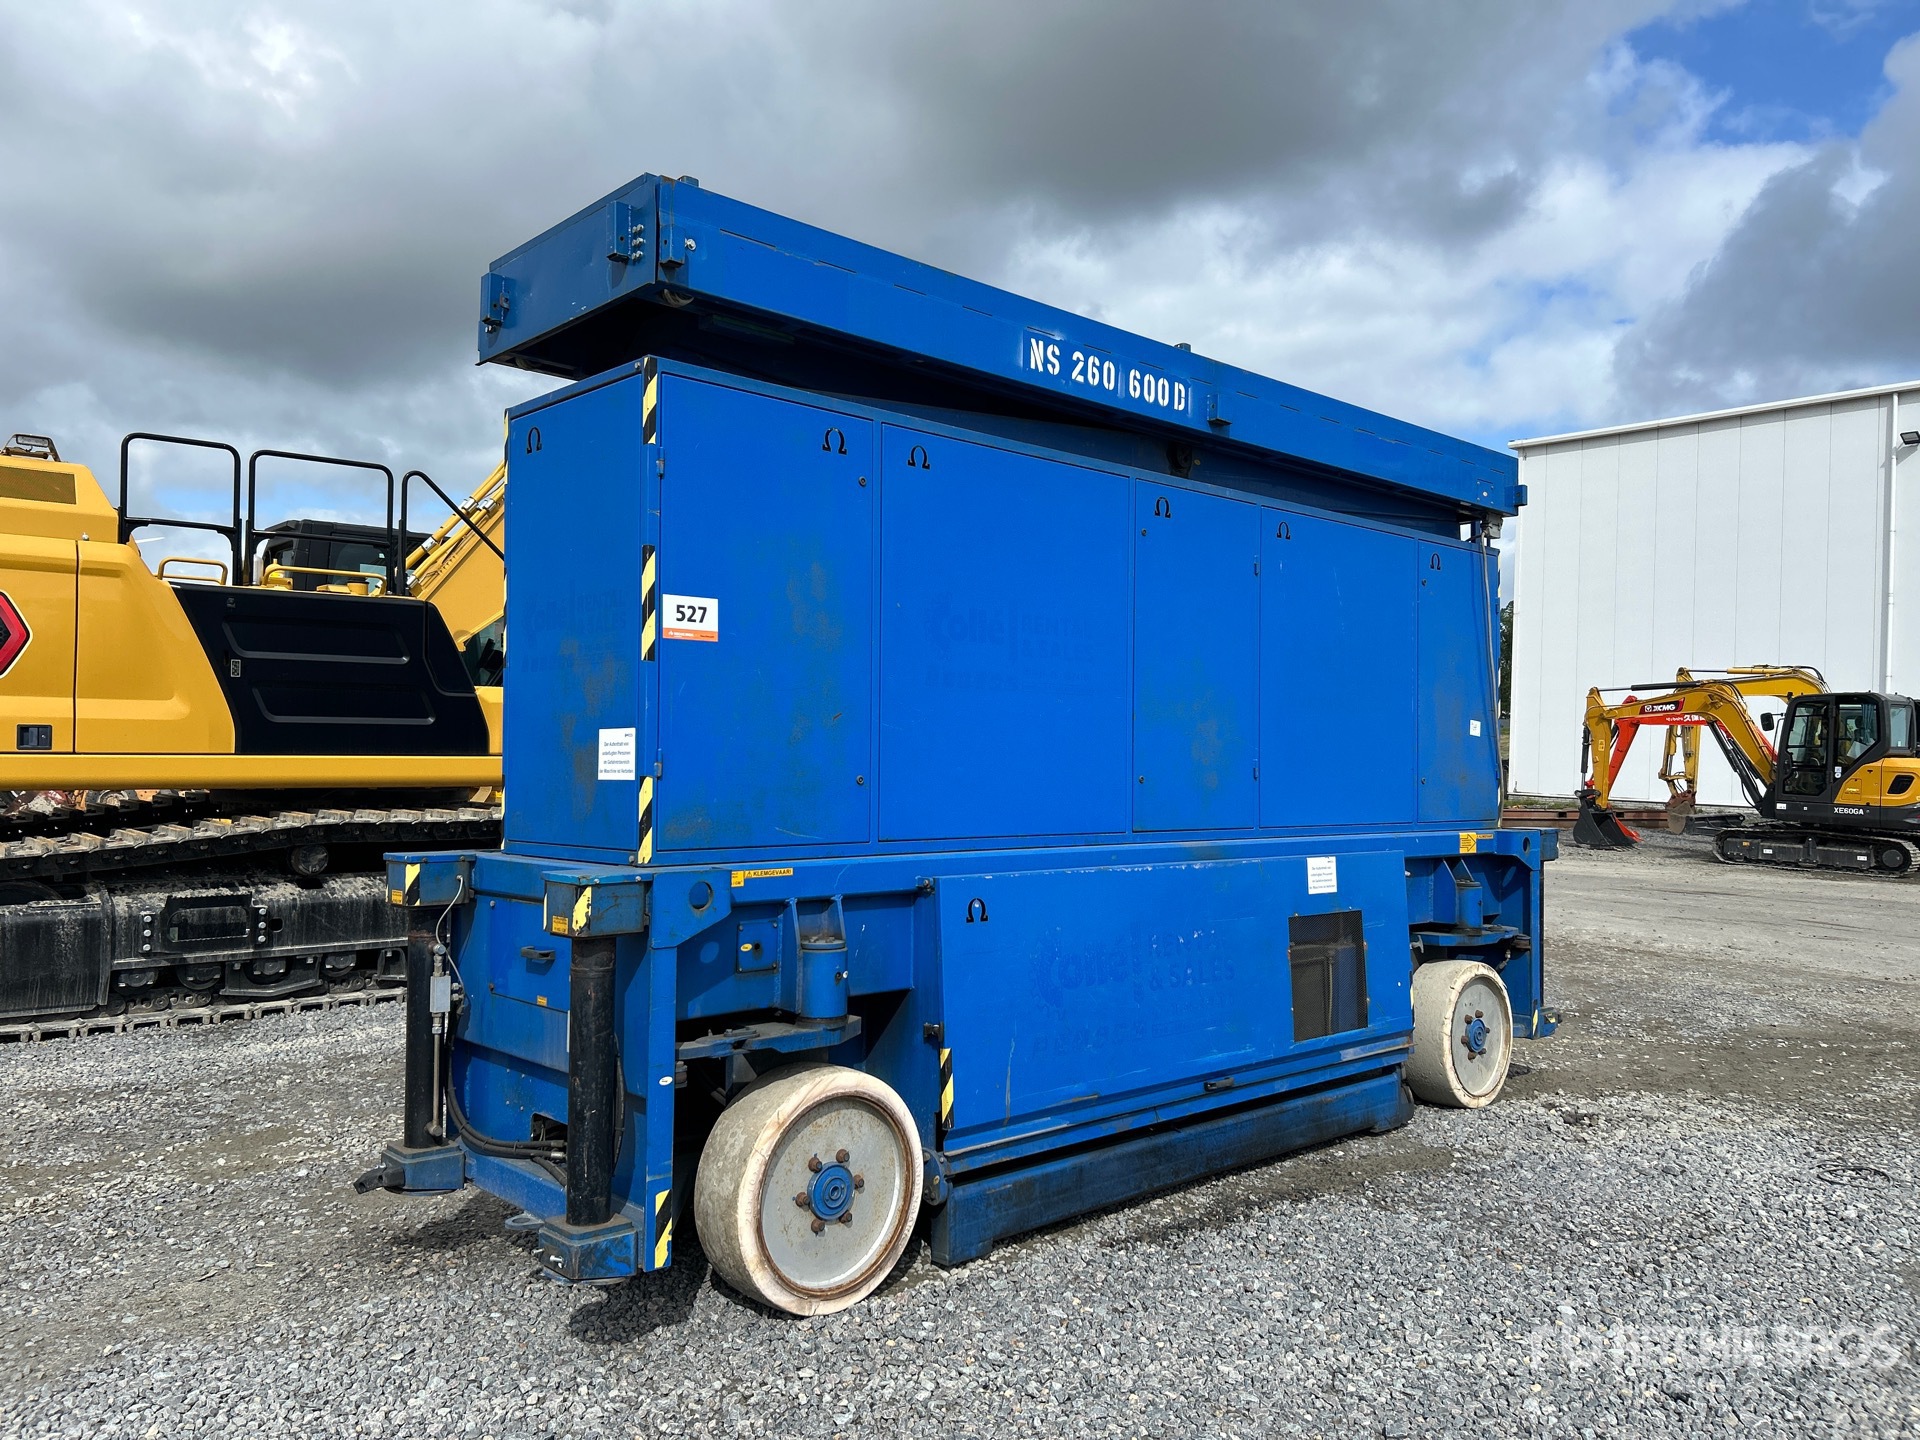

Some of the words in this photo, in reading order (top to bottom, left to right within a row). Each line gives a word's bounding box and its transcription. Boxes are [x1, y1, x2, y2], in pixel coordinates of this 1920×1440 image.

[1030, 337, 1061, 376] NS
[1071, 350, 1116, 391] 260
[675, 604, 708, 624] 527
[1653, 704, 1676, 712] XCMG
[1834, 807, 1864, 815] XE60GA
